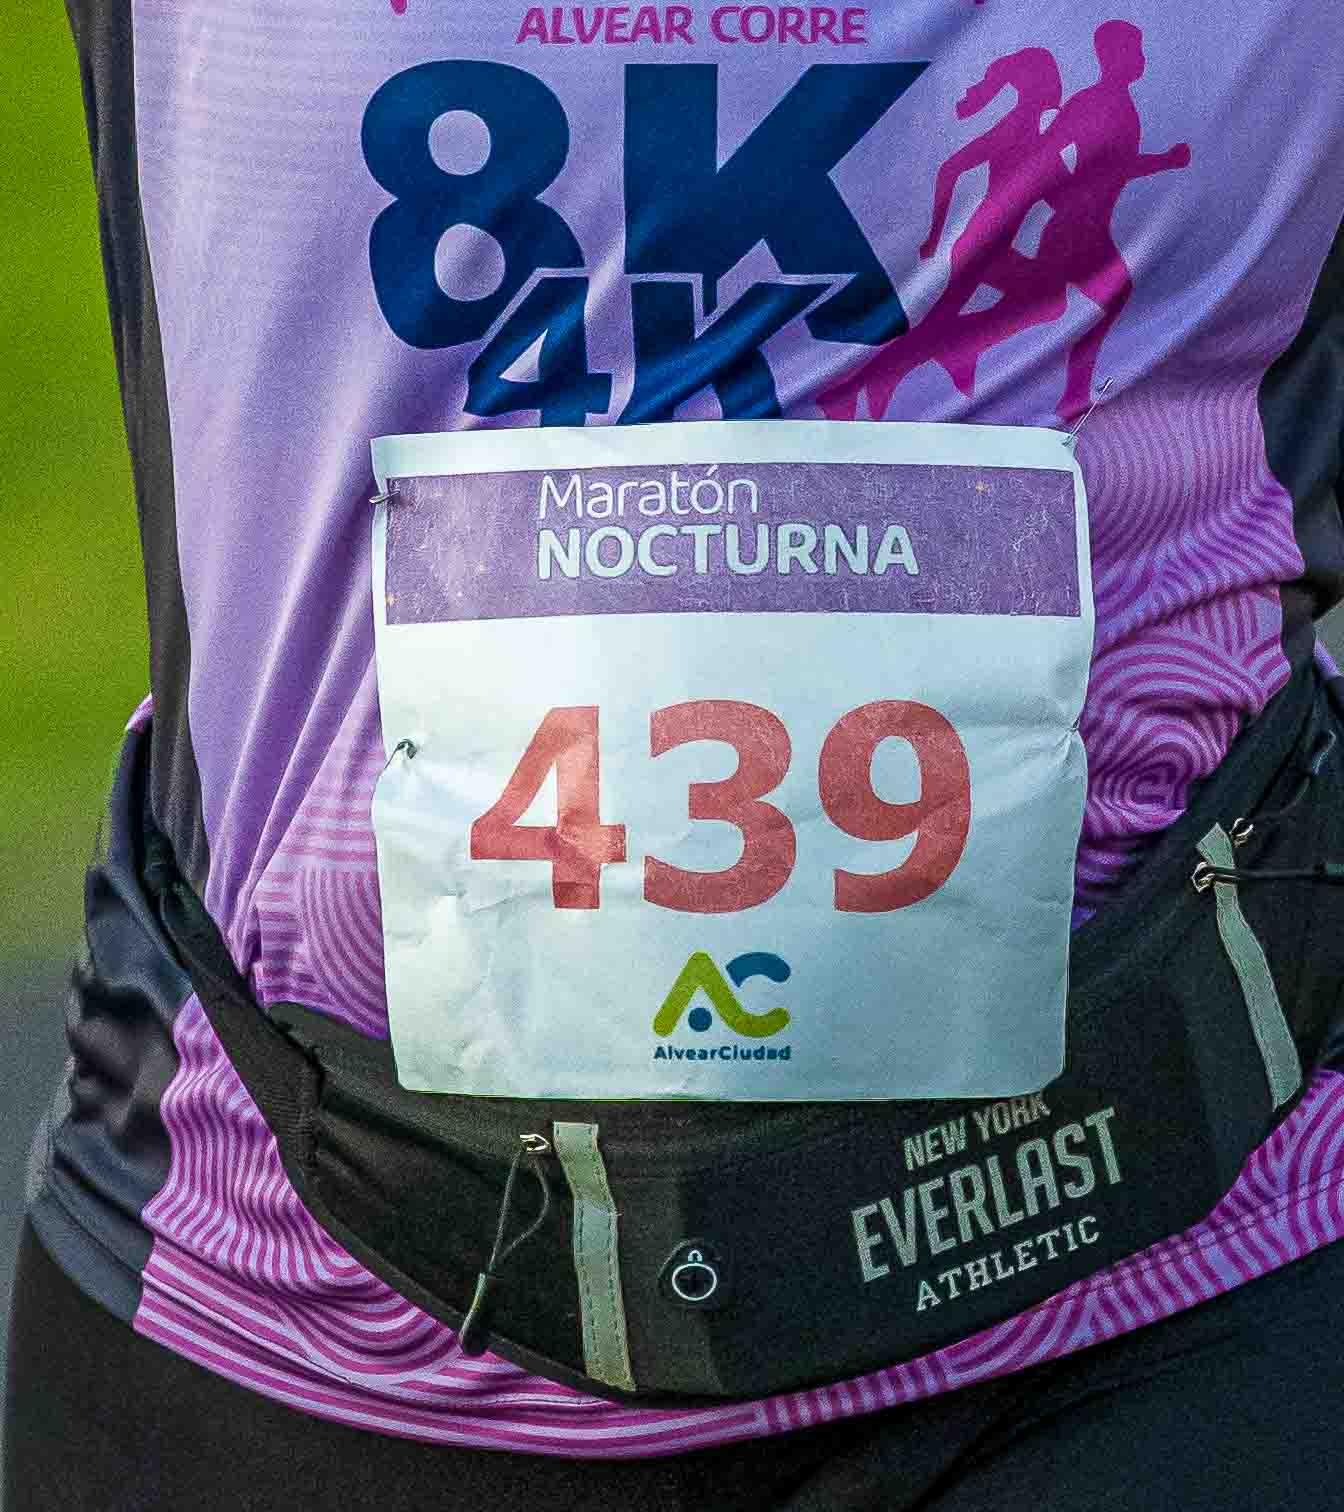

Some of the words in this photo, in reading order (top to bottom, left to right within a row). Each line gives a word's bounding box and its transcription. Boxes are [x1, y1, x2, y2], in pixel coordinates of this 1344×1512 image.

[516, 5, 696, 45] ALVEAR
[711, 5, 867, 45] CORRE
[463, 273, 830, 426] 4K
[538, 464, 759, 519] Maratón
[537, 522, 920, 580] NOCTURNA
[470, 699, 972, 914] 439
[904, 1116, 968, 1170] NEW
[972, 1091, 1051, 1143] YORK
[851, 1106, 1122, 1283] EVERLAST
[915, 1215, 1100, 1312] ATHLETIC
